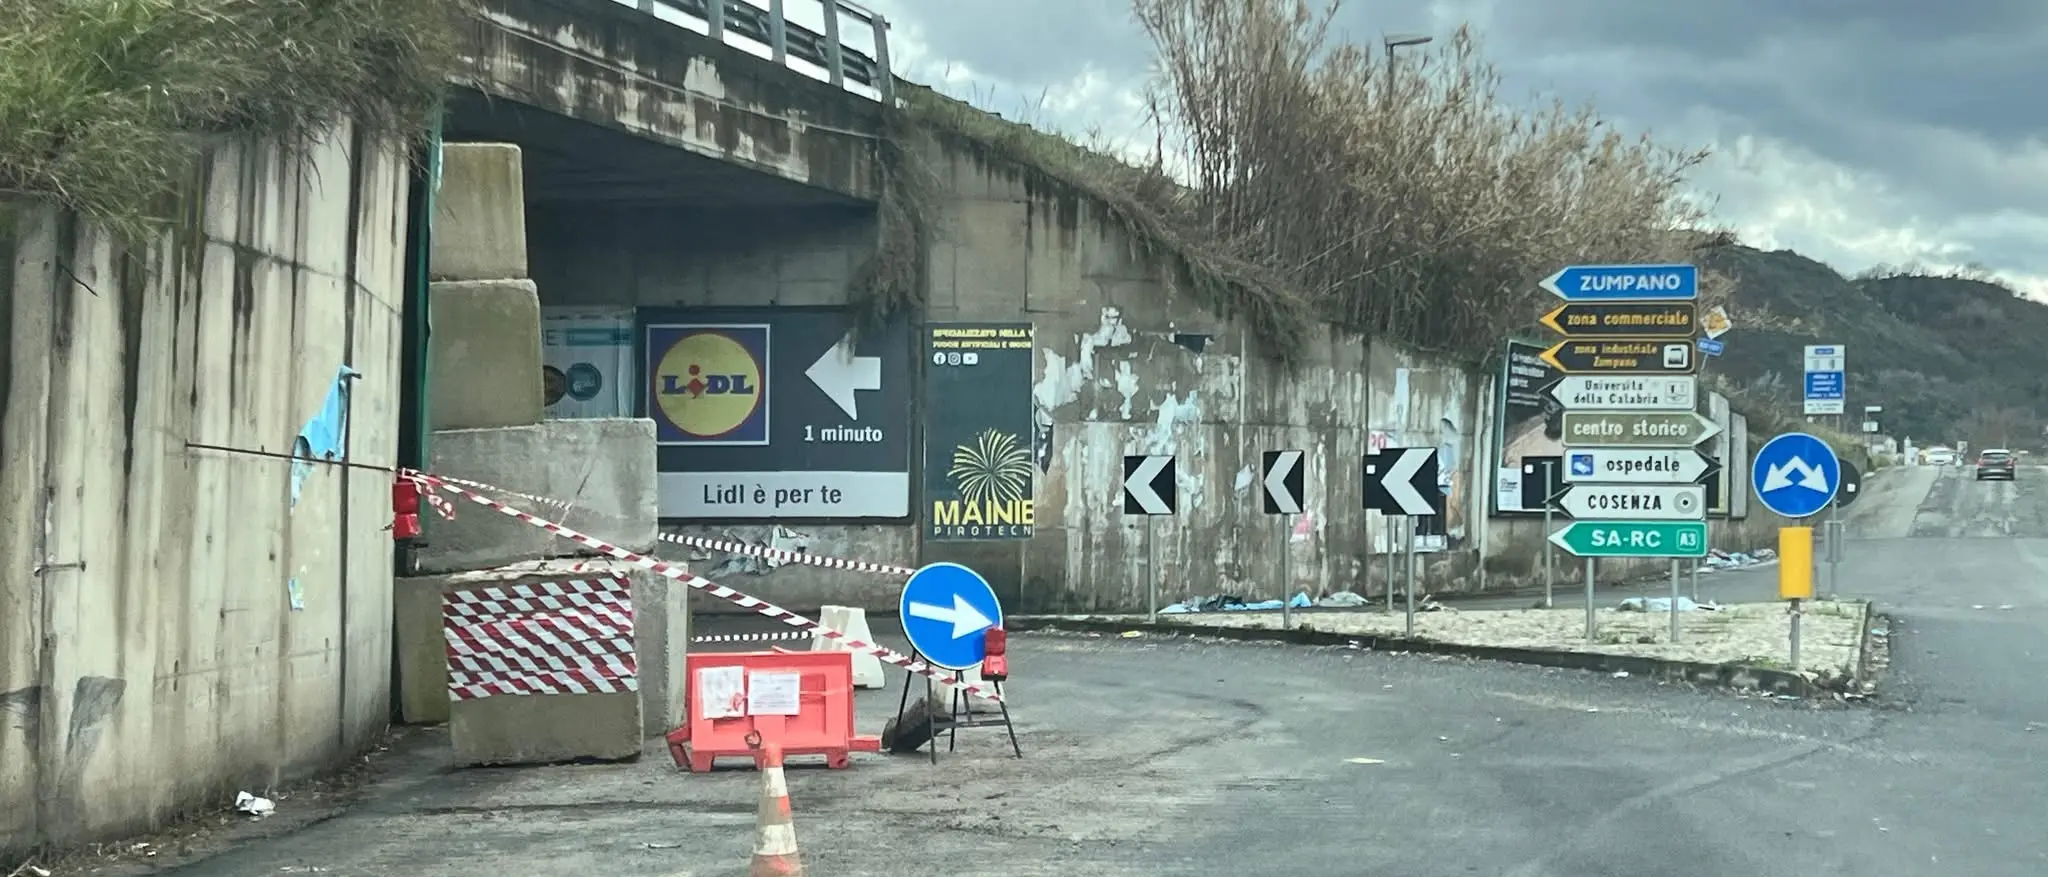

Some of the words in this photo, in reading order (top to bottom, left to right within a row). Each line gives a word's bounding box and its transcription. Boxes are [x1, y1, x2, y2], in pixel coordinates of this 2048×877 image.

[1580, 273, 1681, 291] ZUMPANO
[1567, 314, 1597, 326] zona
[1603, 311, 1689, 326] commerciale
[1574, 345, 1597, 354] zona
[1601, 344, 1658, 354] industriale
[1593, 356, 1637, 368] Zumpano
[661, 364, 754, 399] LIDL
[1574, 393, 1603, 404] della
[1609, 393, 1658, 404] Calabria
[804, 425, 814, 442] 1
[821, 425, 883, 442] minuto
[1573, 419, 1623, 436] centro
[1632, 419, 1688, 436] storico
[1606, 456, 1680, 475] ospedale
[703, 484, 744, 504] Lidl
[753, 484, 766, 504] è
[775, 488, 813, 508] per
[821, 485, 842, 504] te
[1587, 494, 1662, 510] COSENZA
[934, 526, 1031, 536] PIROTECN
[1591, 529, 1661, 547] SA-RC
[1679, 532, 1697, 546] A3
